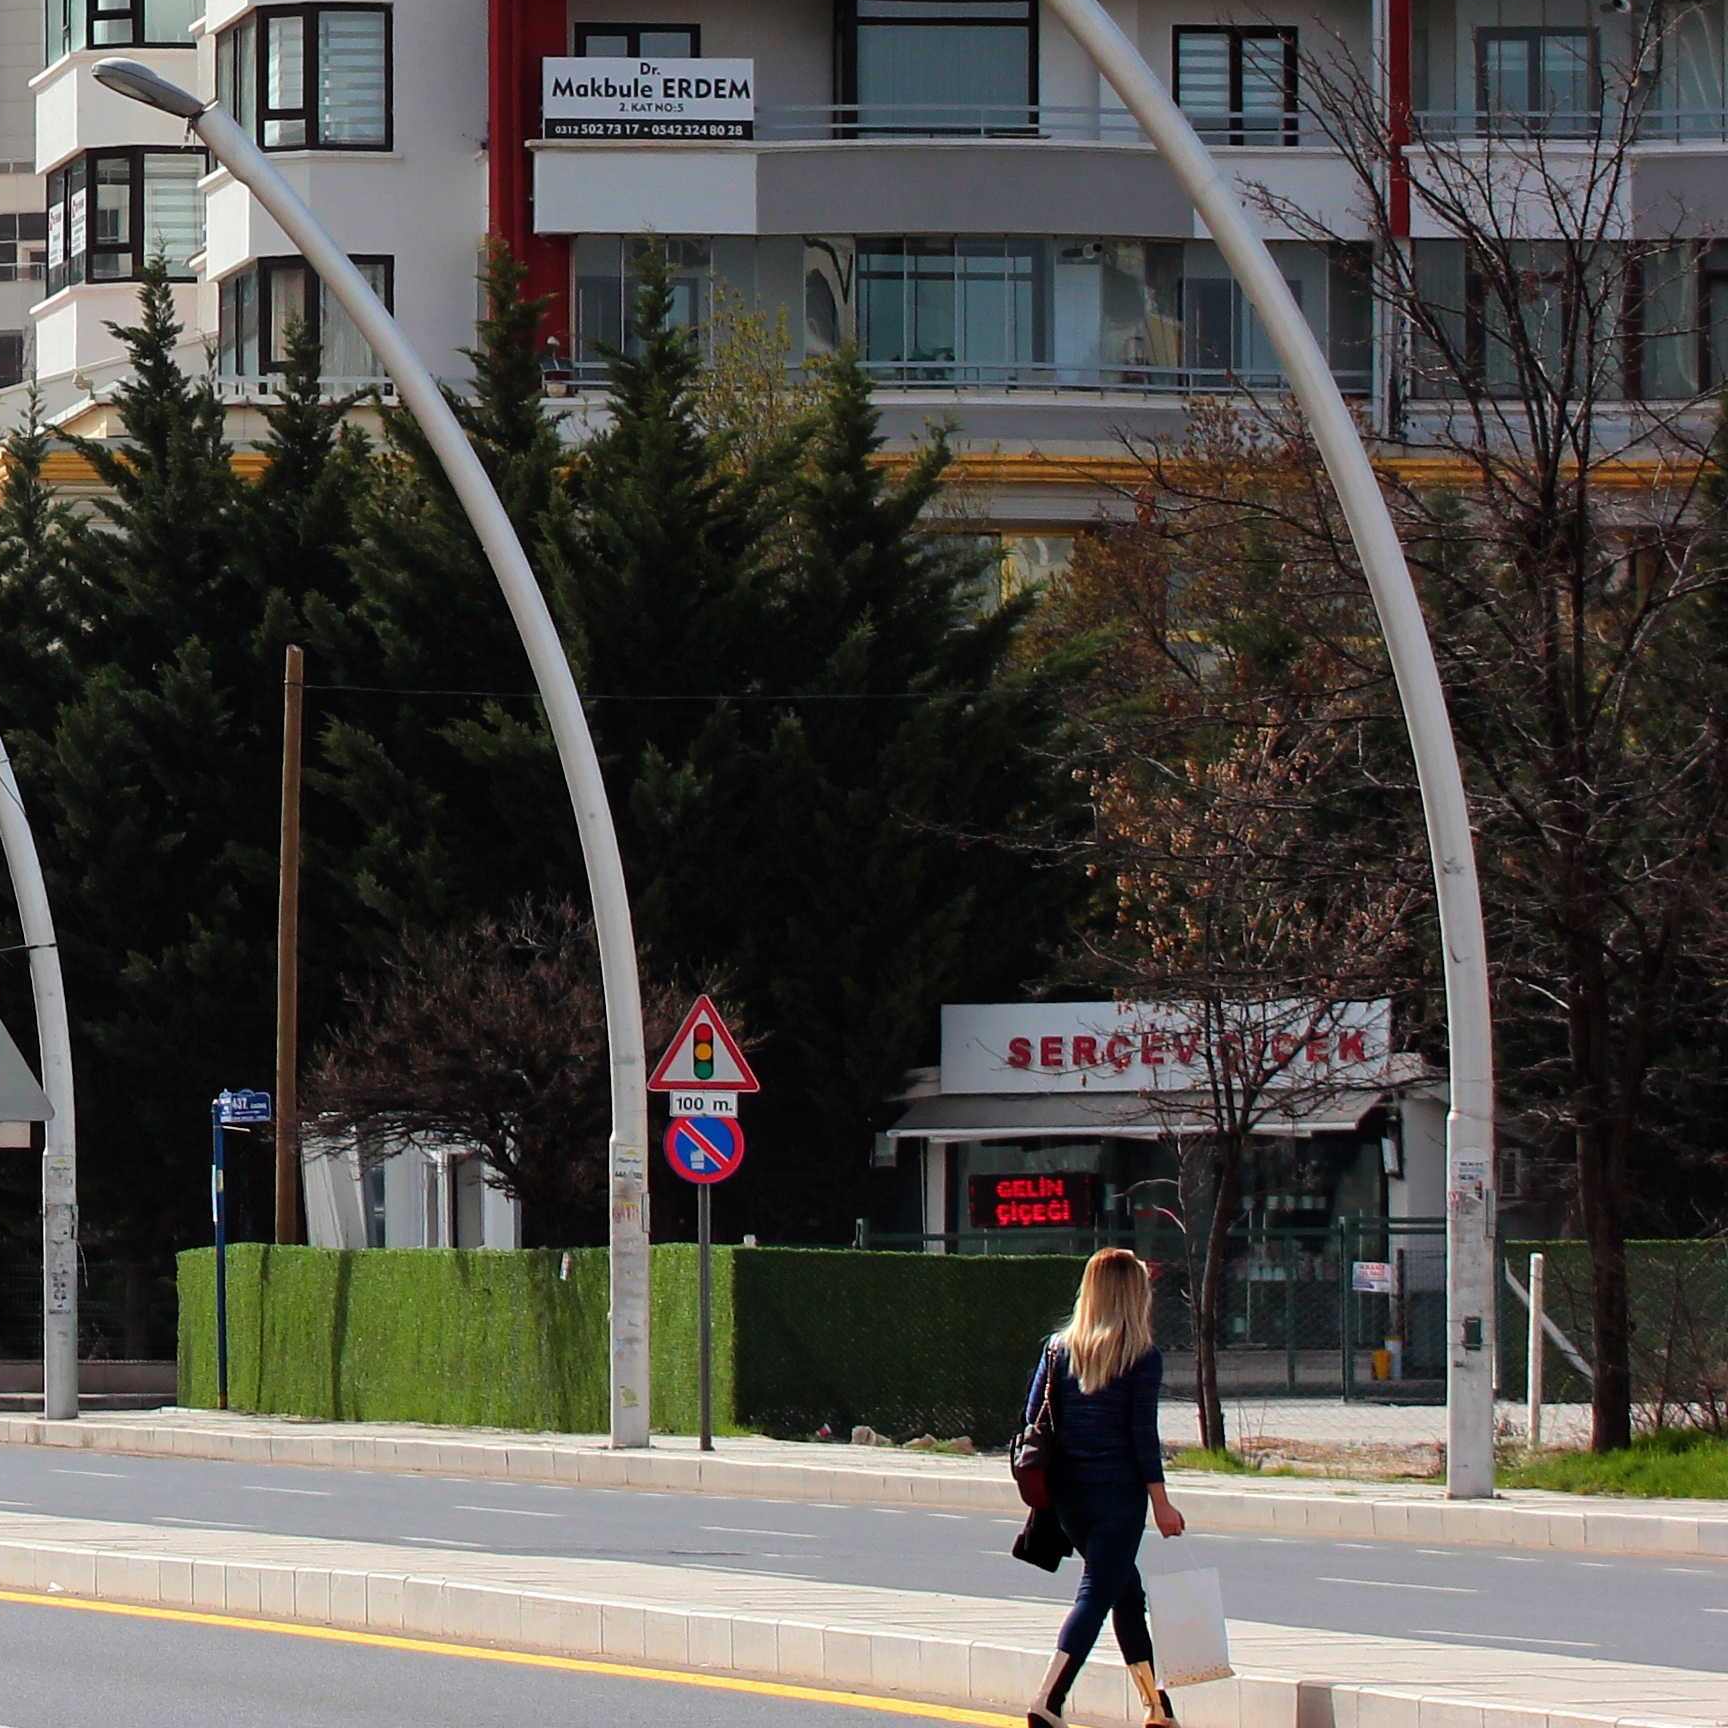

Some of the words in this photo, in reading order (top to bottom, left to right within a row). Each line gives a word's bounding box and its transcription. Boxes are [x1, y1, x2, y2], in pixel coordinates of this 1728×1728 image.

[639, 62, 661, 76] Dr.
[551, 76, 653, 98] Makbule
[662, 78, 751, 99] ERDEM
[618, 102, 629, 112] 2.
[630, 102, 653, 113] KAT
[653, 102, 684, 113] NO:5
[554, 125, 579, 135] 0312
[580, 123, 604, 136] 502
[605, 124, 622, 136] 73
[624, 124, 640, 136] 17
[651, 125, 684, 136] 0542
[684, 125, 708, 136] 324
[709, 125, 726, 136] 80
[727, 125, 743, 136] 28
[676, 1097, 704, 1111] 100
[713, 1100, 733, 1111] m.
[996, 1176, 1064, 1198] GELİN
[996, 1199, 1071, 1226] ÇİÇEĞİ
